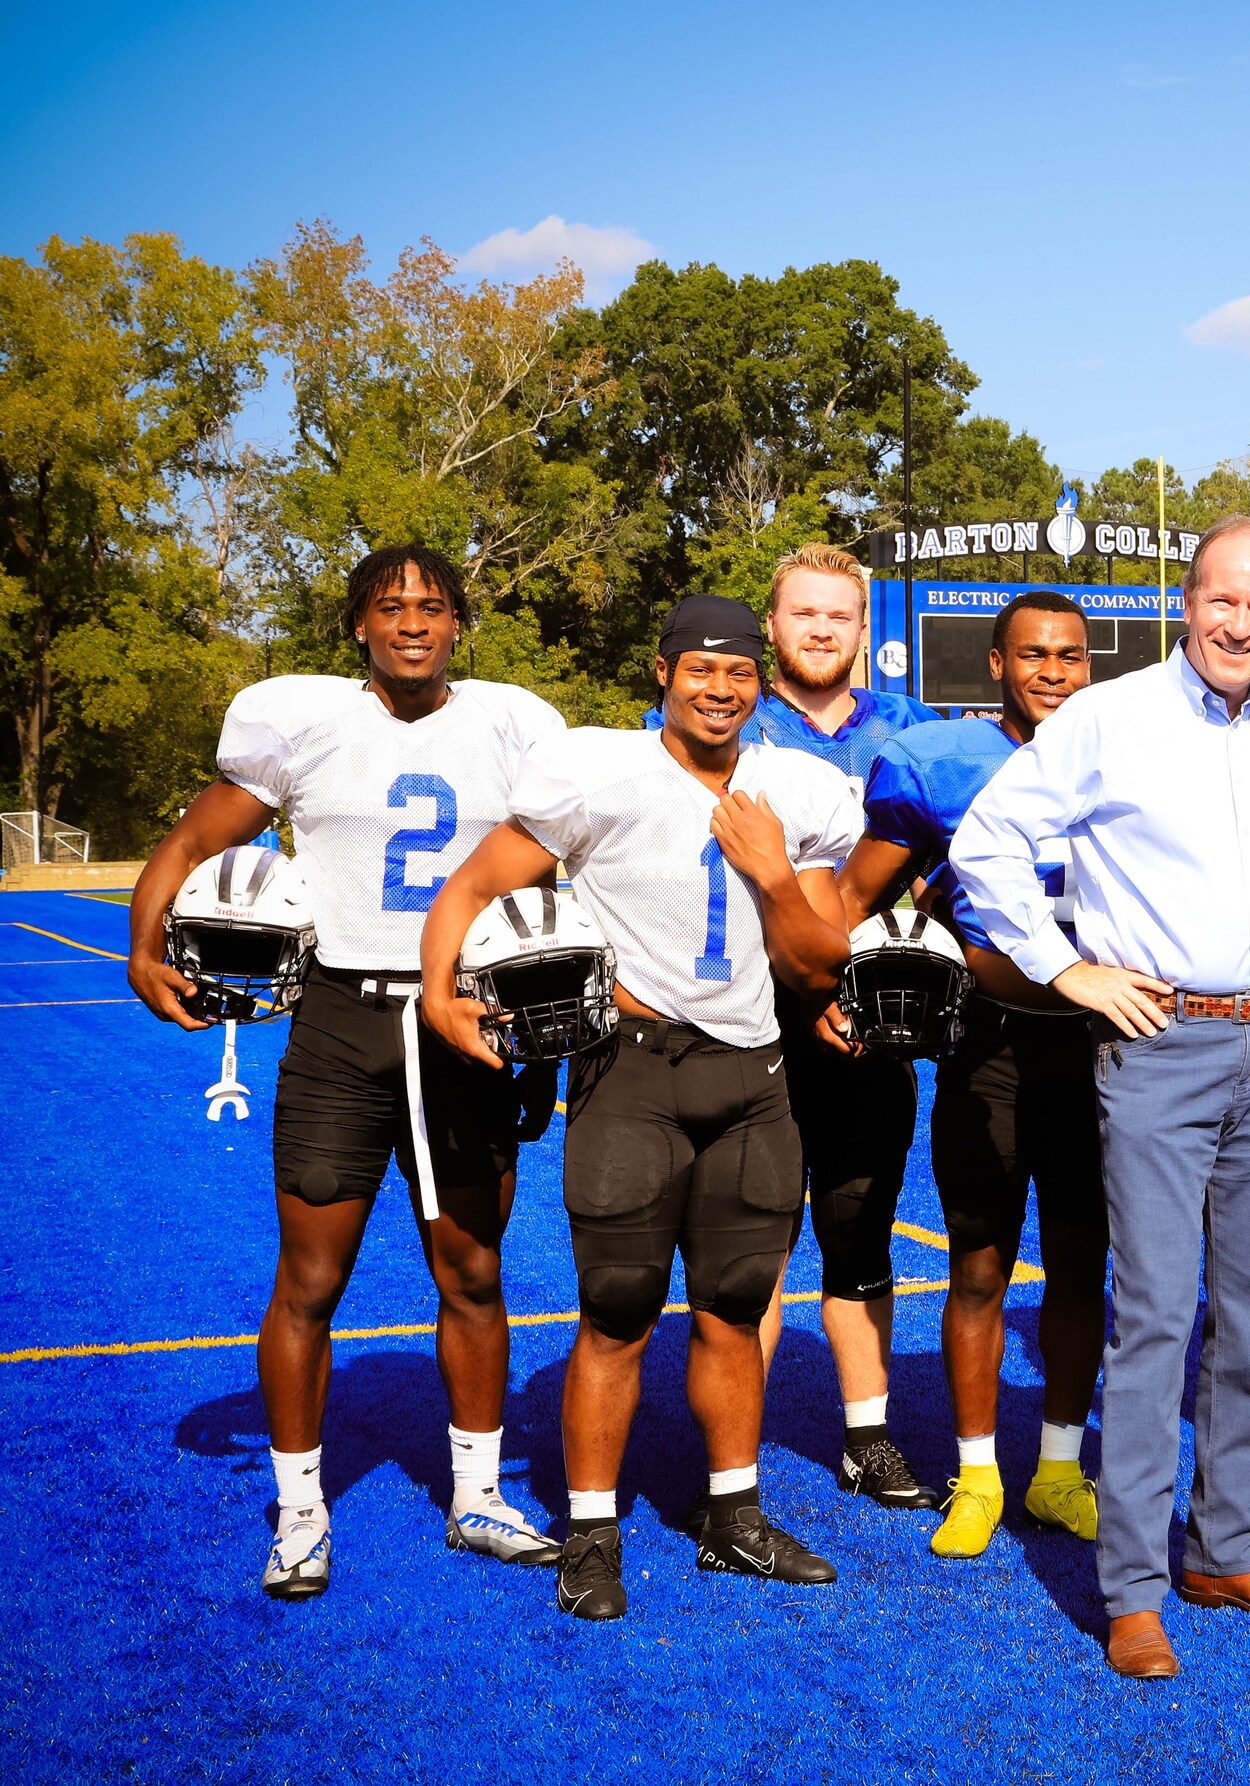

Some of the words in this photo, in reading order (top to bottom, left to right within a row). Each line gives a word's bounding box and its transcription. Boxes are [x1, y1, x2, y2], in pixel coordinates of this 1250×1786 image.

[895, 522, 1038, 562] BARTON
[928, 591, 1010, 606] ELECTRIC
[1080, 594, 1160, 609] COMPANY
[382, 774, 457, 912] 2
[695, 836, 732, 982] 1
[885, 940, 924, 949] Riddell
